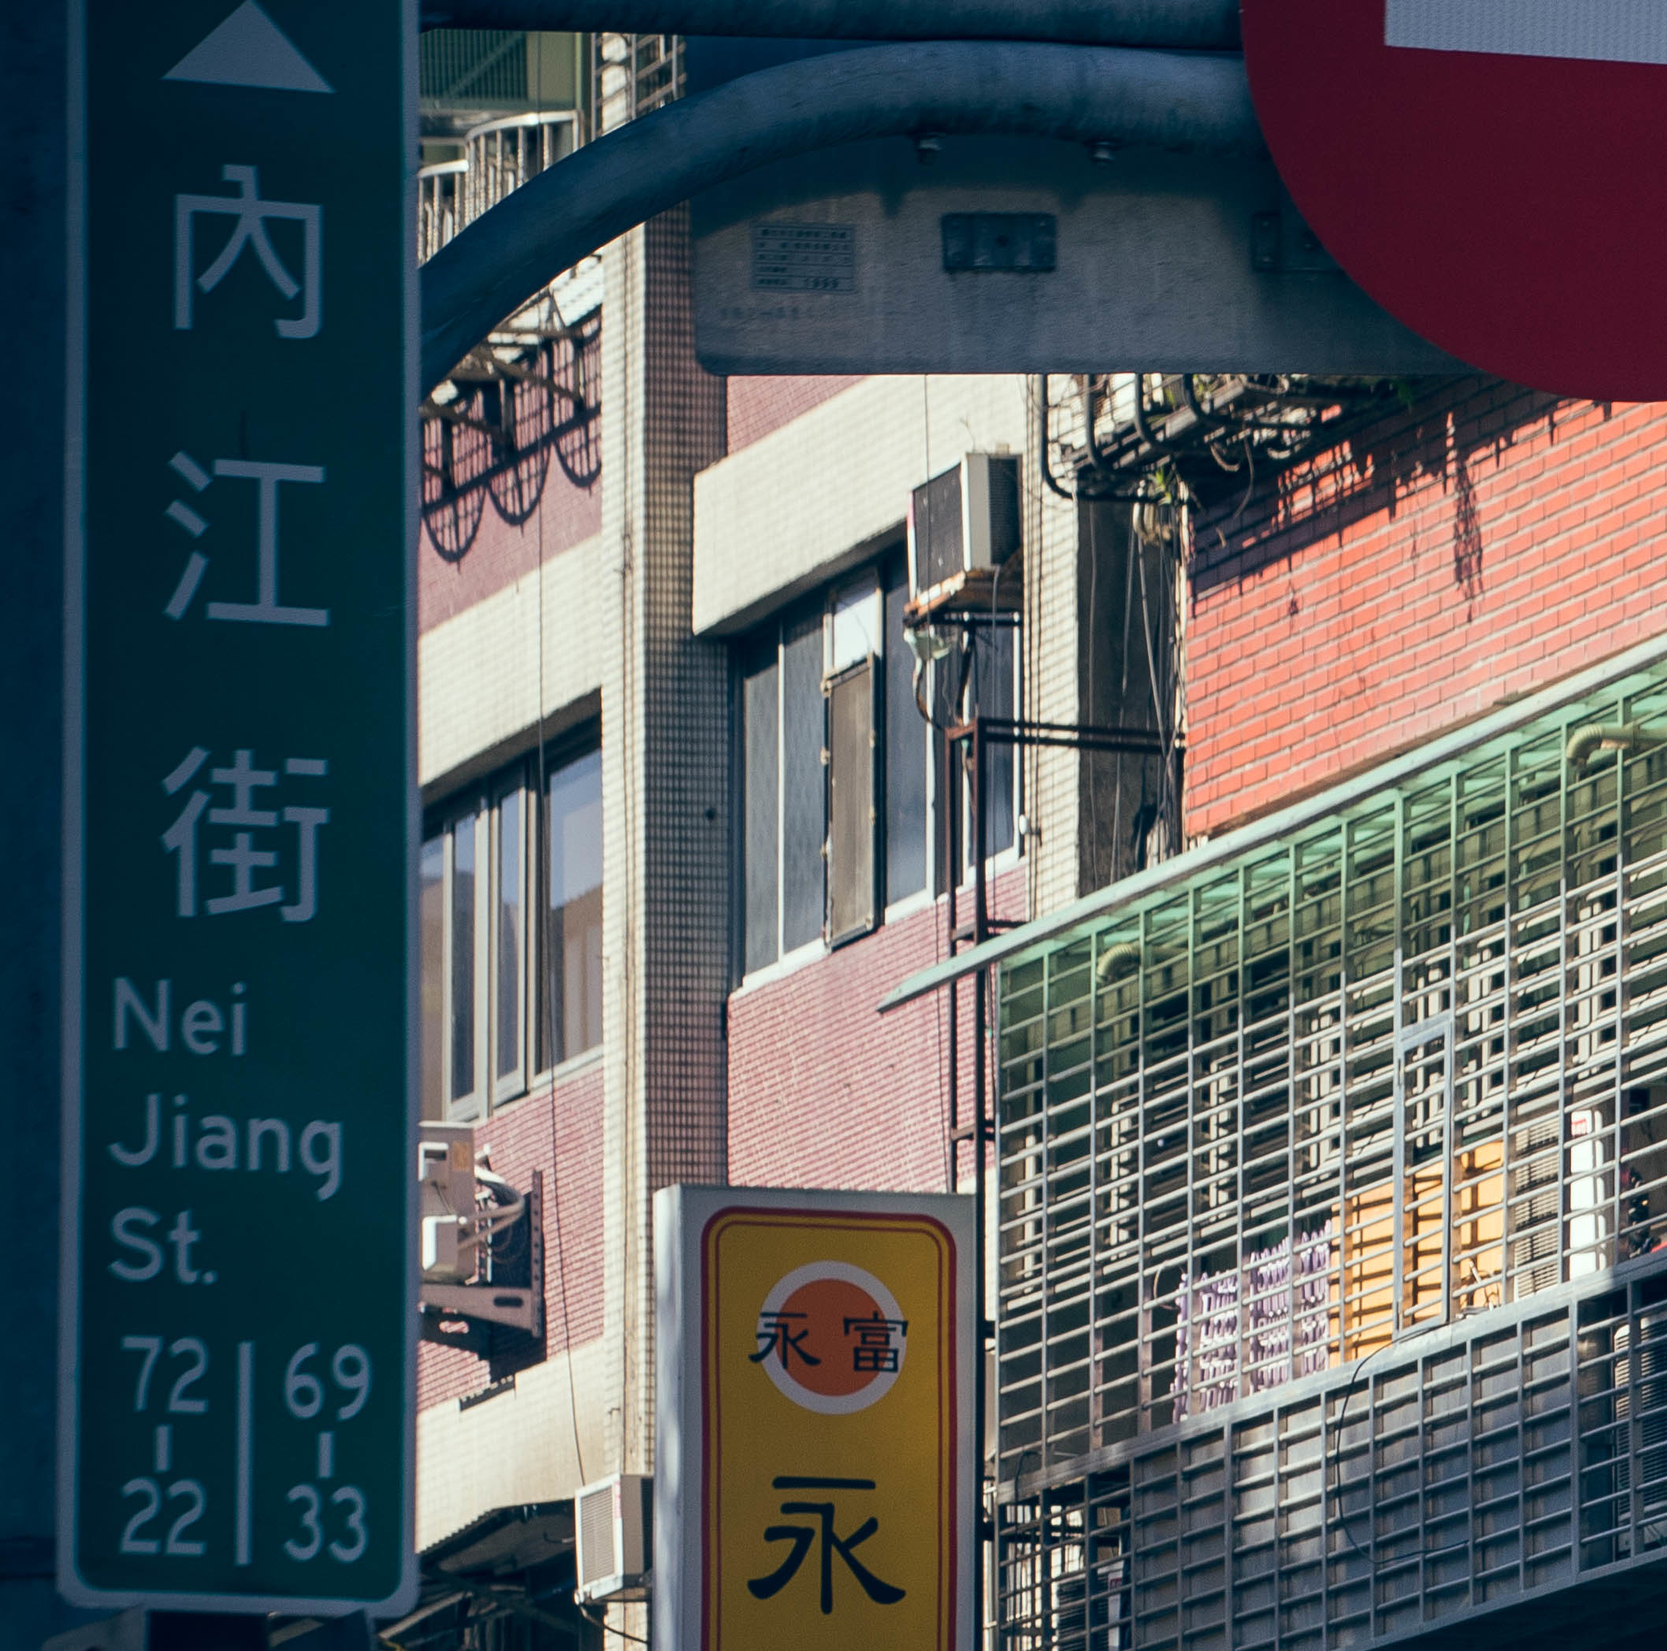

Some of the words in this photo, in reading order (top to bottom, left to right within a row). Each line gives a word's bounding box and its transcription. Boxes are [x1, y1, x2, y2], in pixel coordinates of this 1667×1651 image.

[162, 164, 330, 922] 內江街
[114, 978, 247, 1056] Nei
[108, 1094, 343, 1200] Jiang
[110, 1207, 217, 1284] St.
[121, 1335, 209, 1414] 72
[748, 1309, 908, 1373] 永富
[283, 1342, 371, 1420] 69
[120, 1477, 206, 1556] 22
[283, 1484, 368, 1563] 33
